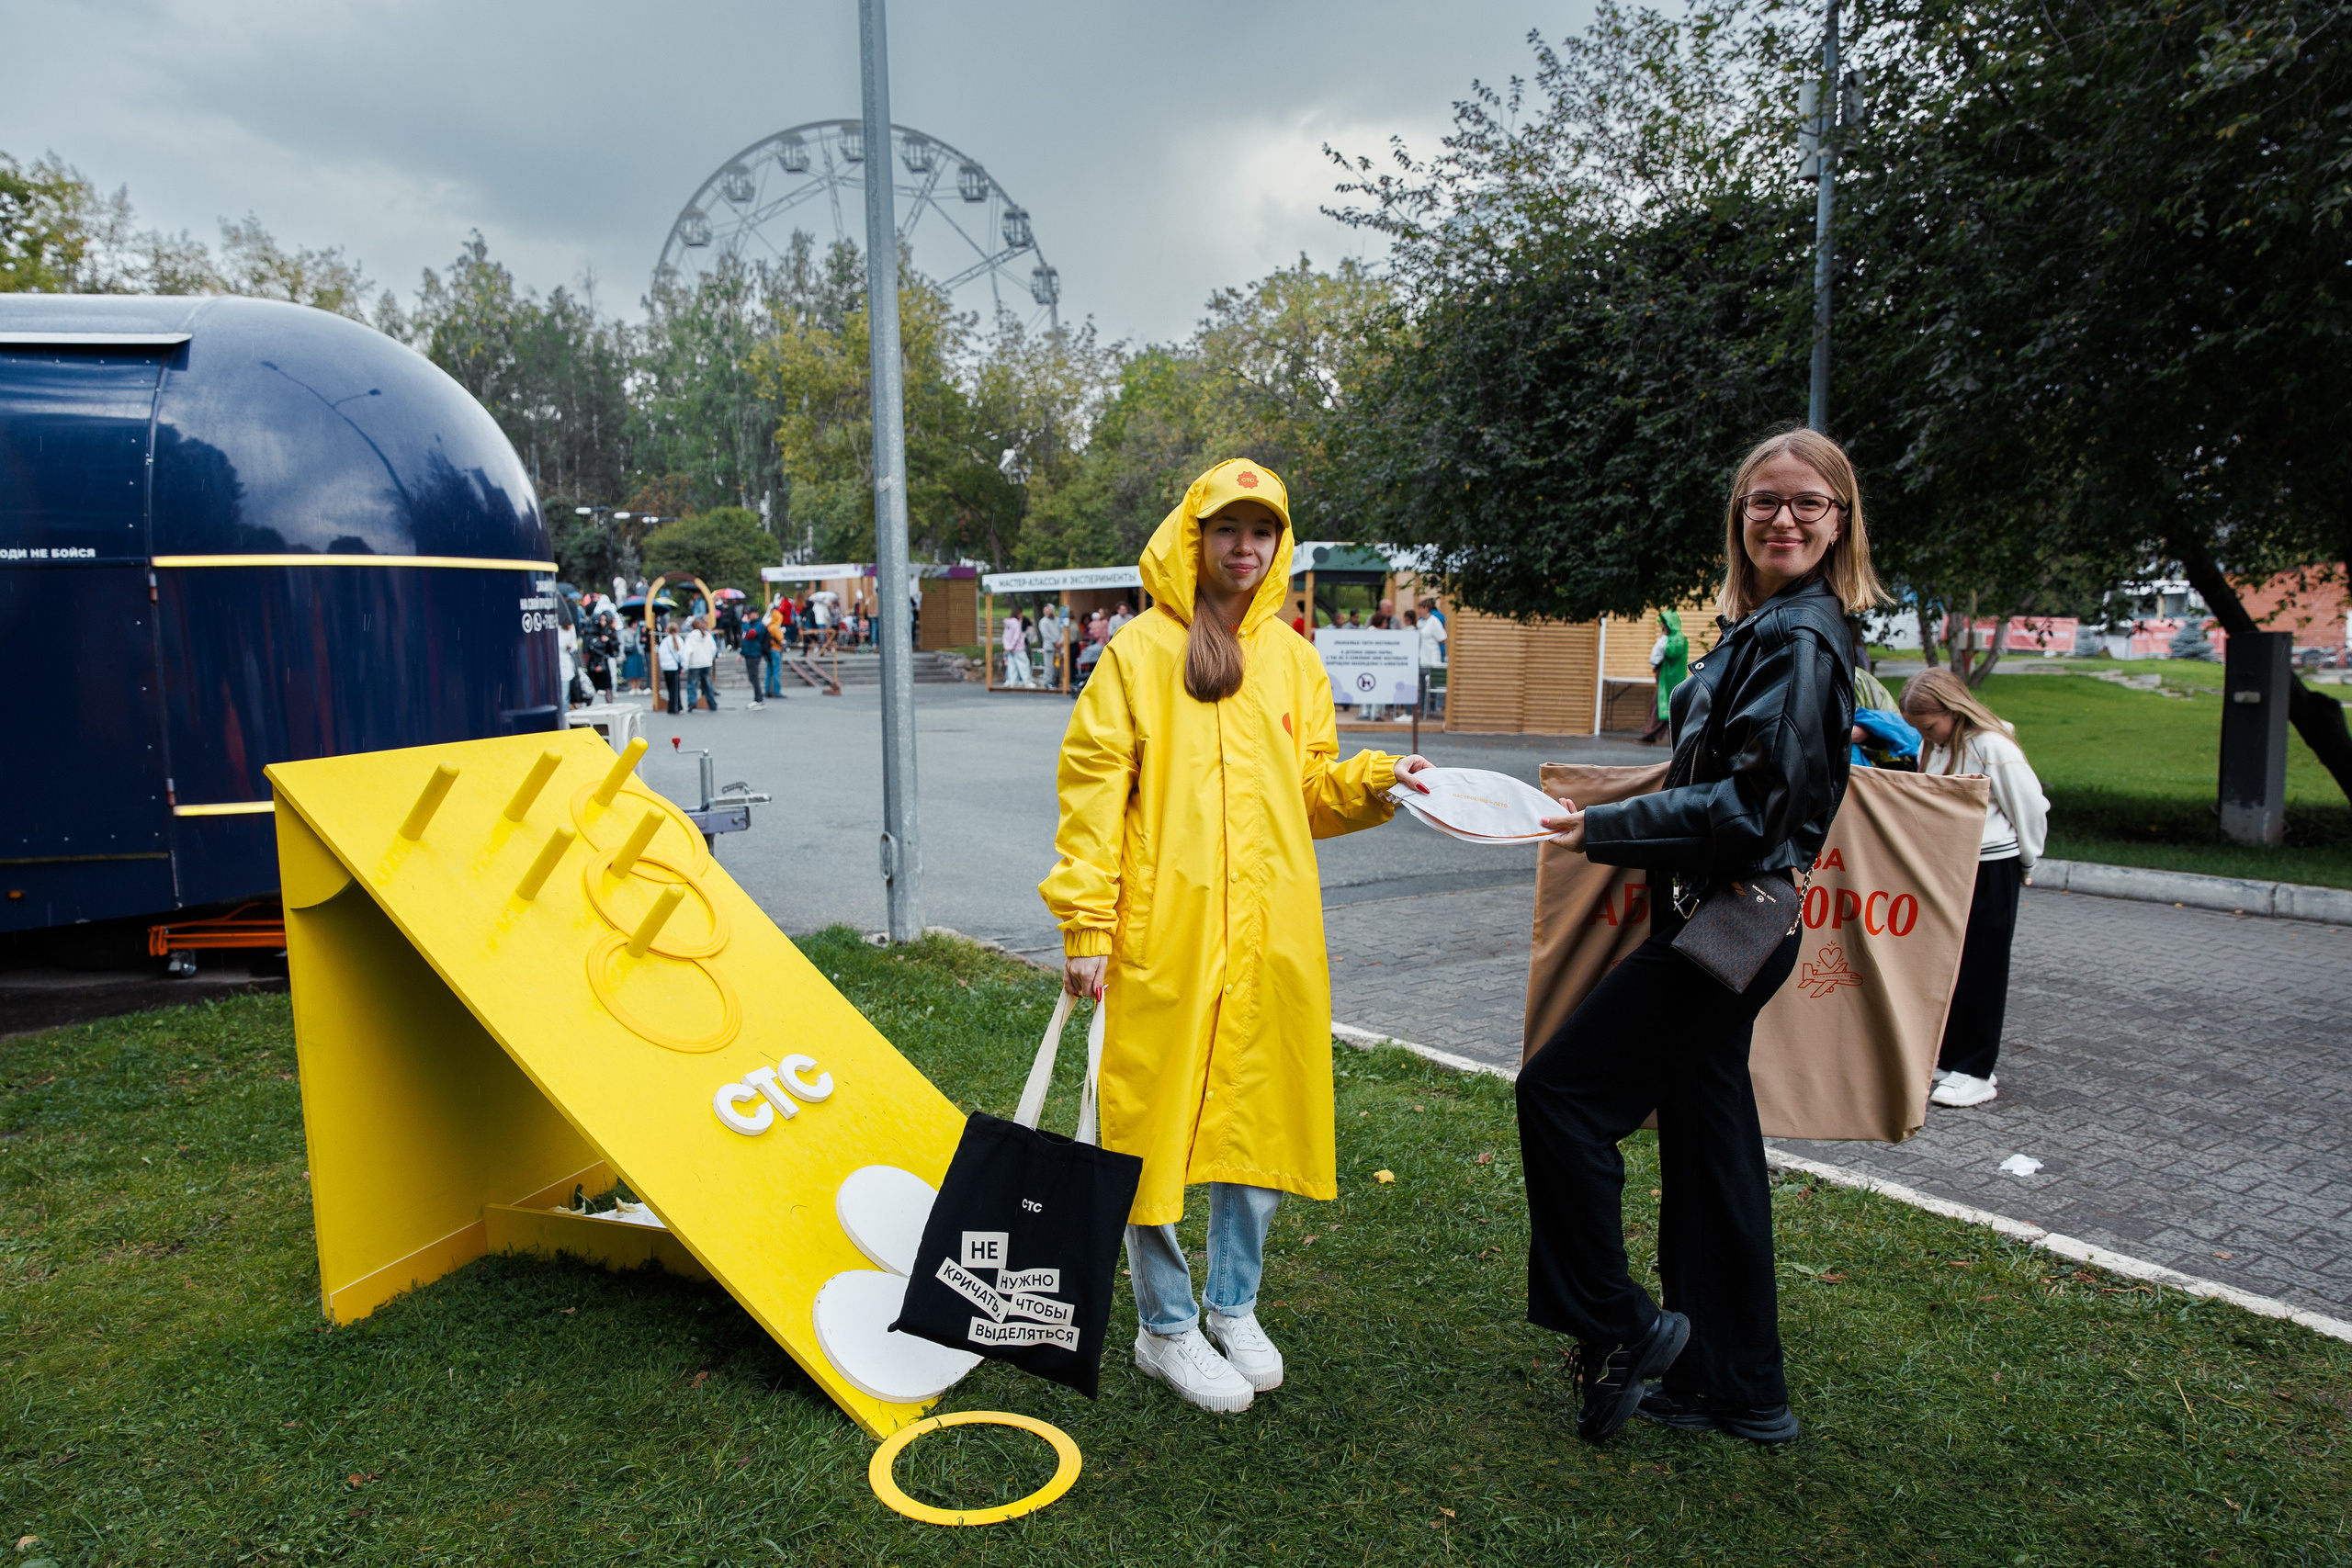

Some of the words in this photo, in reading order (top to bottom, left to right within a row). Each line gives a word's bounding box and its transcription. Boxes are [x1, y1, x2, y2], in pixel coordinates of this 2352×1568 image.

[30, 548, 49, 558] НЕ
[51, 546, 96, 558] БОЙСЯ
[713, 1054, 834, 1136] СТС
[1022, 1198, 1043, 1213] СТС
[971, 1241, 999, 1260] НЕ
[943, 1265, 1001, 1318] КРИЧАТЬ,
[1000, 1274, 1054, 1290] НУЖНО
[1016, 1298, 1068, 1320] ЧТОБЫ
[975, 1323, 1074, 1344] ВЫДЕЛЯТЬСЯ
